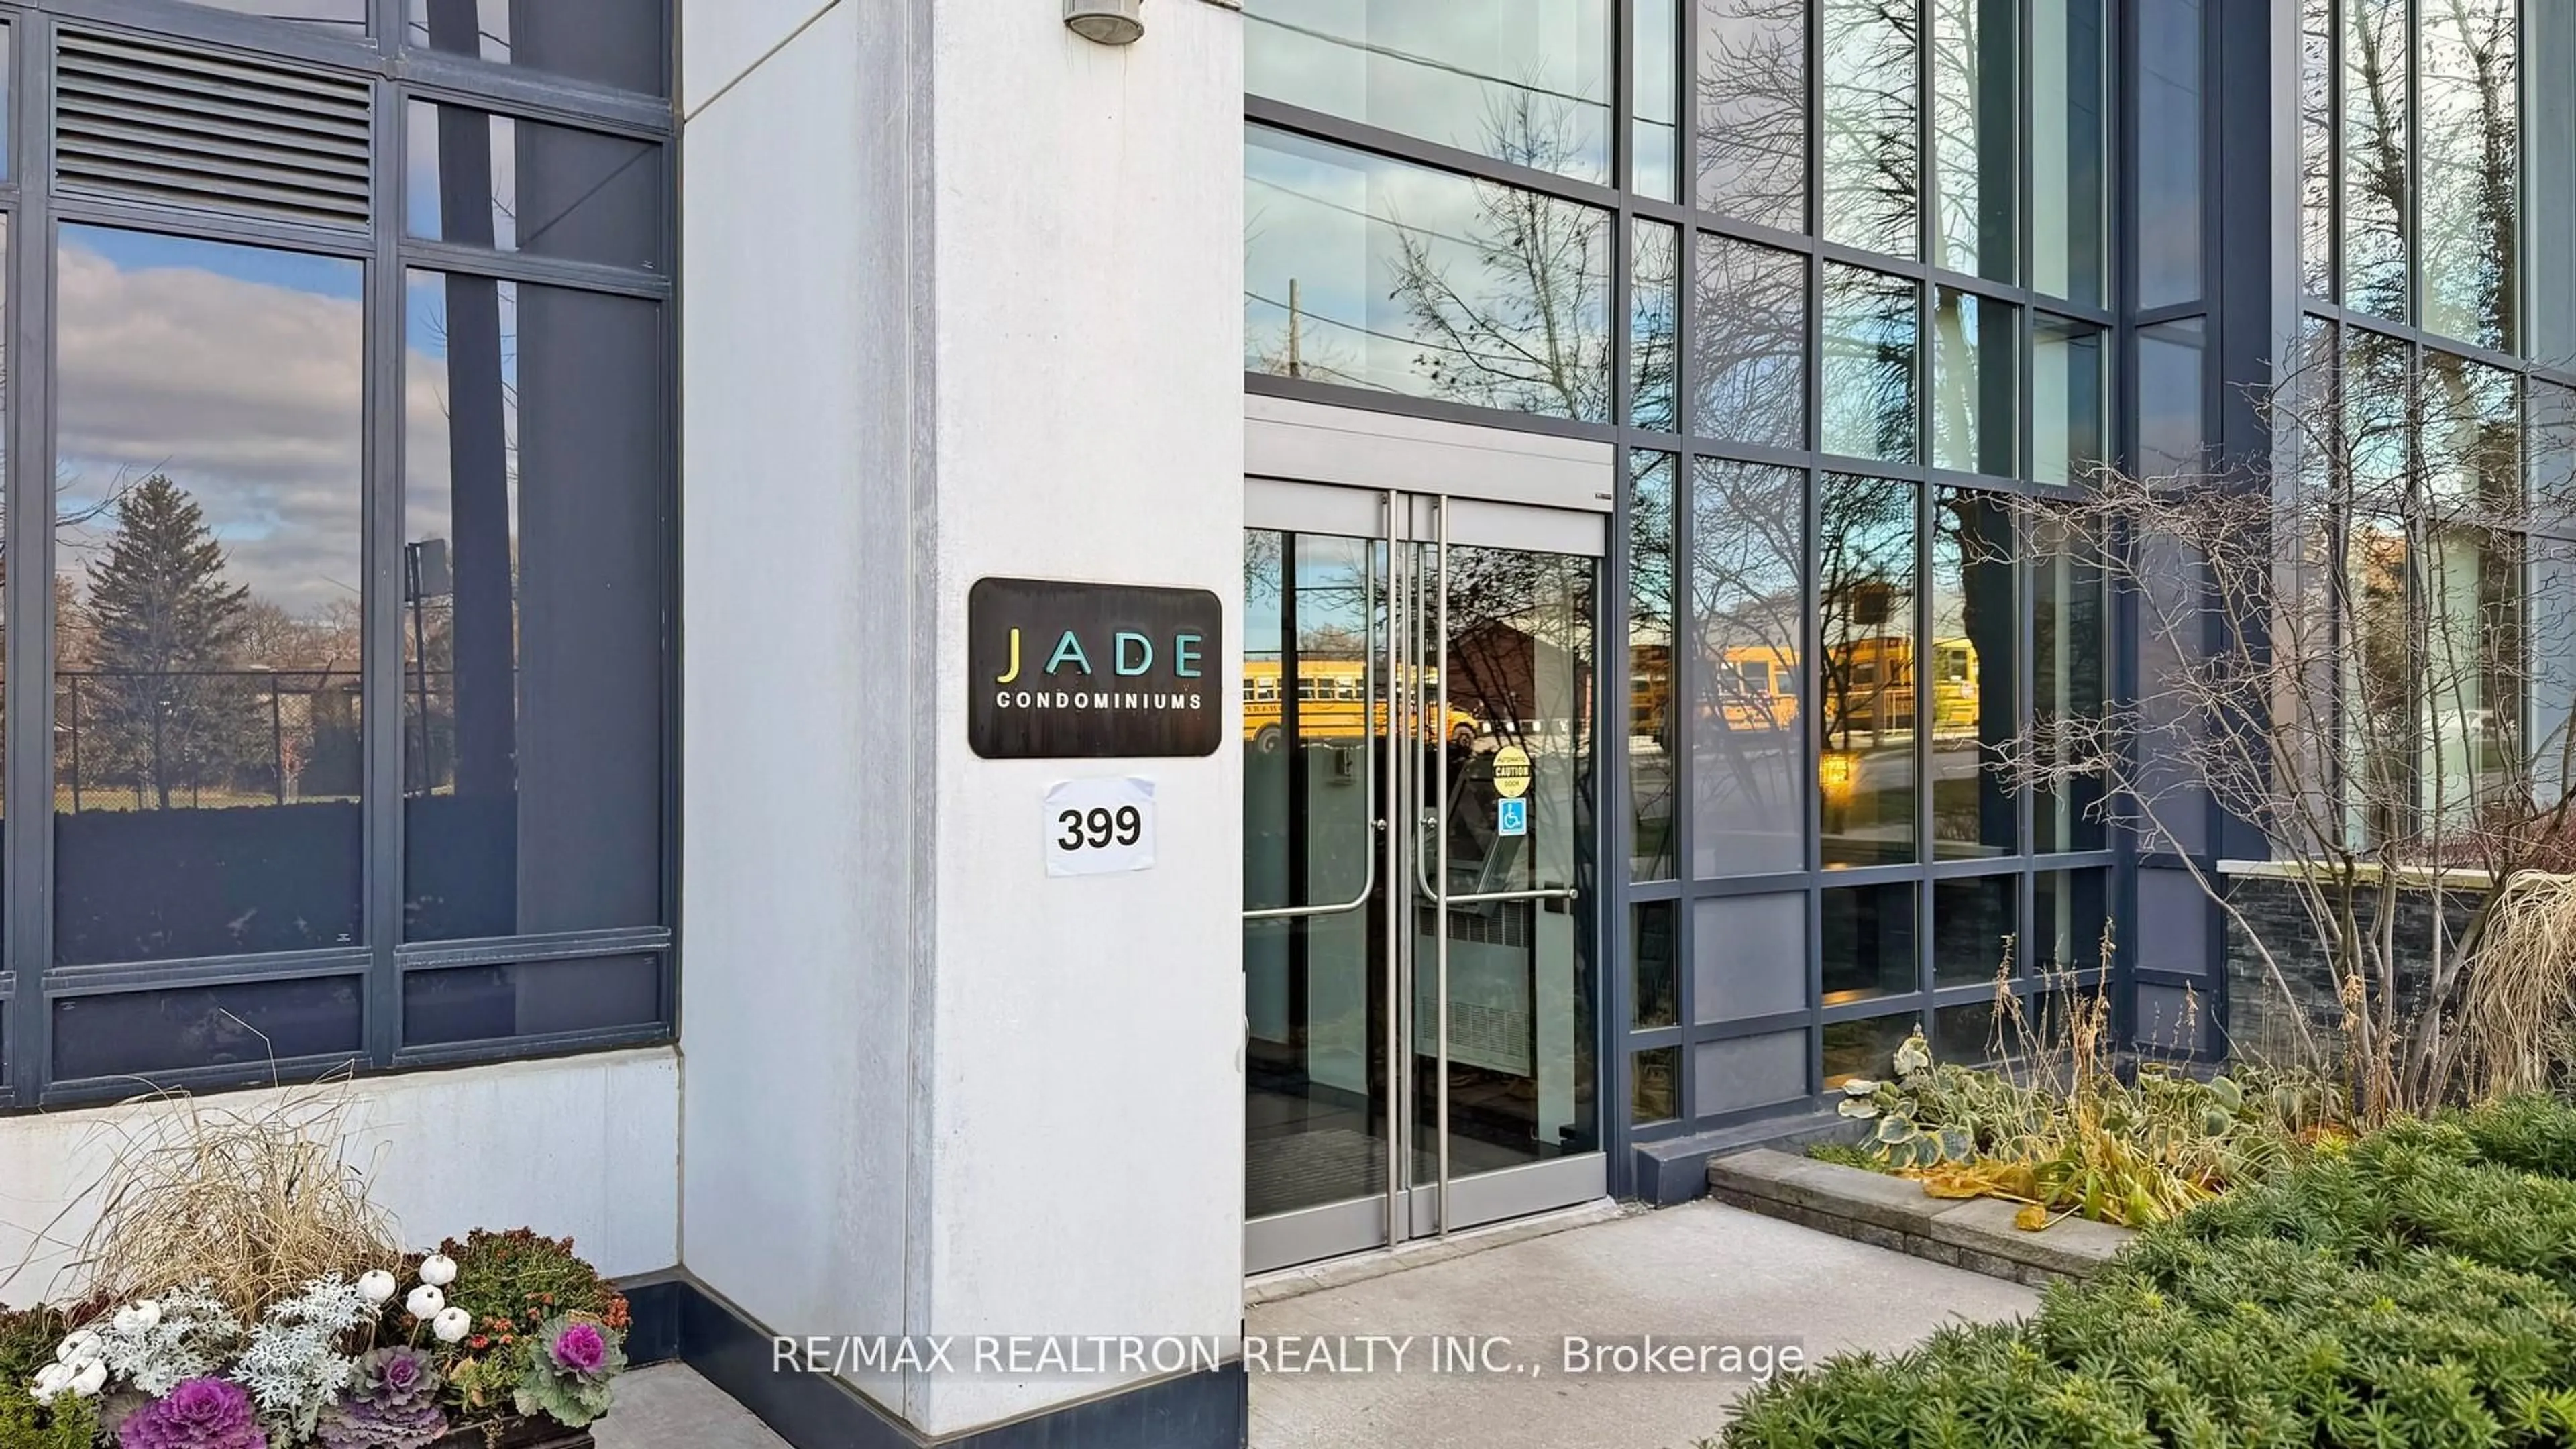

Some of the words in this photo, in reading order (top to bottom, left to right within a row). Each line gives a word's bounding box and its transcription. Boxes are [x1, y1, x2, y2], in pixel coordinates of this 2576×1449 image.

[996, 628, 1202, 684] JADE
[996, 692, 1201, 710] CONDOMINIUMS
[1495, 767, 1529, 777] CAUTION
[1058, 806, 1141, 850] 399
